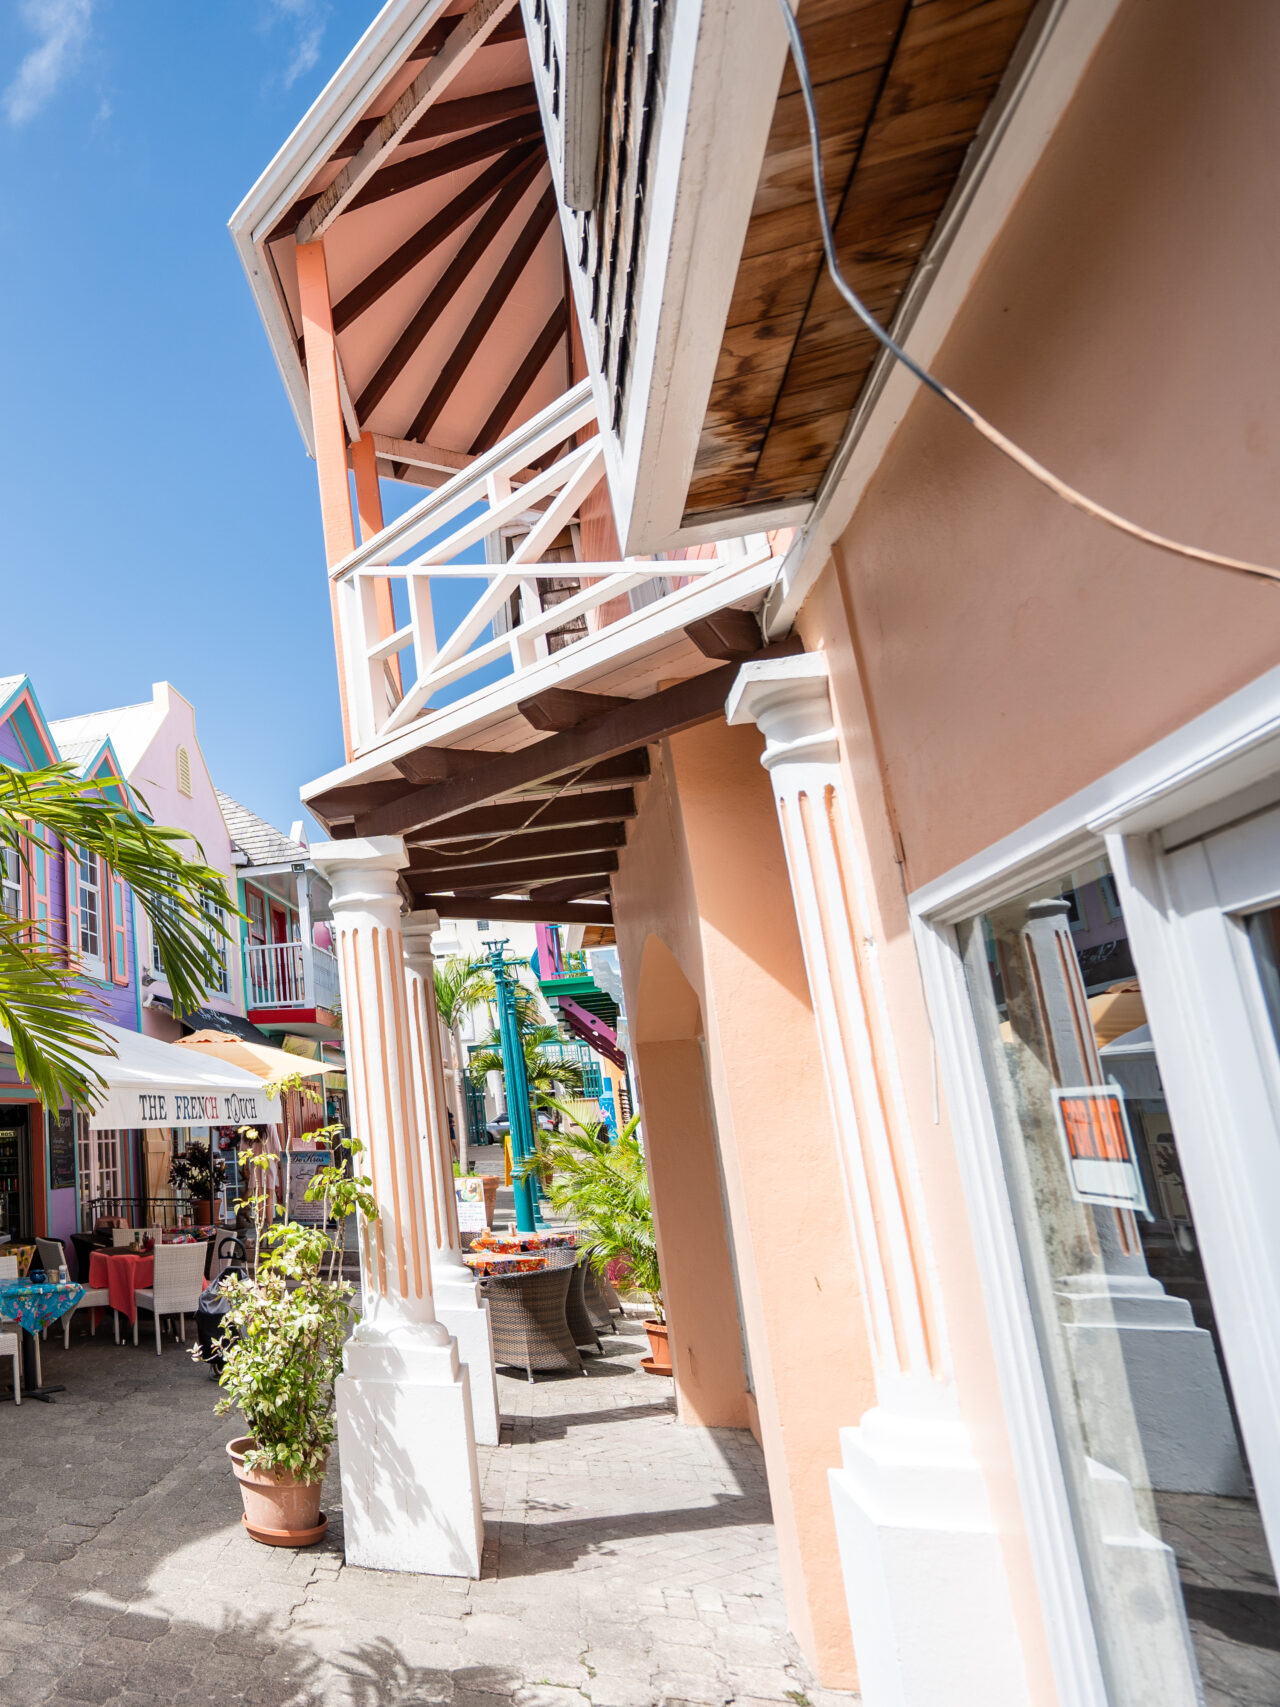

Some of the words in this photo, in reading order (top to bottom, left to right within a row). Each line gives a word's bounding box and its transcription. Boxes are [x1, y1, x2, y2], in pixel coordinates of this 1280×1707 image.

[139, 1094, 167, 1121] THE
[174, 1095, 219, 1120] FRENCH
[224, 1093, 257, 1123] TOUCH
